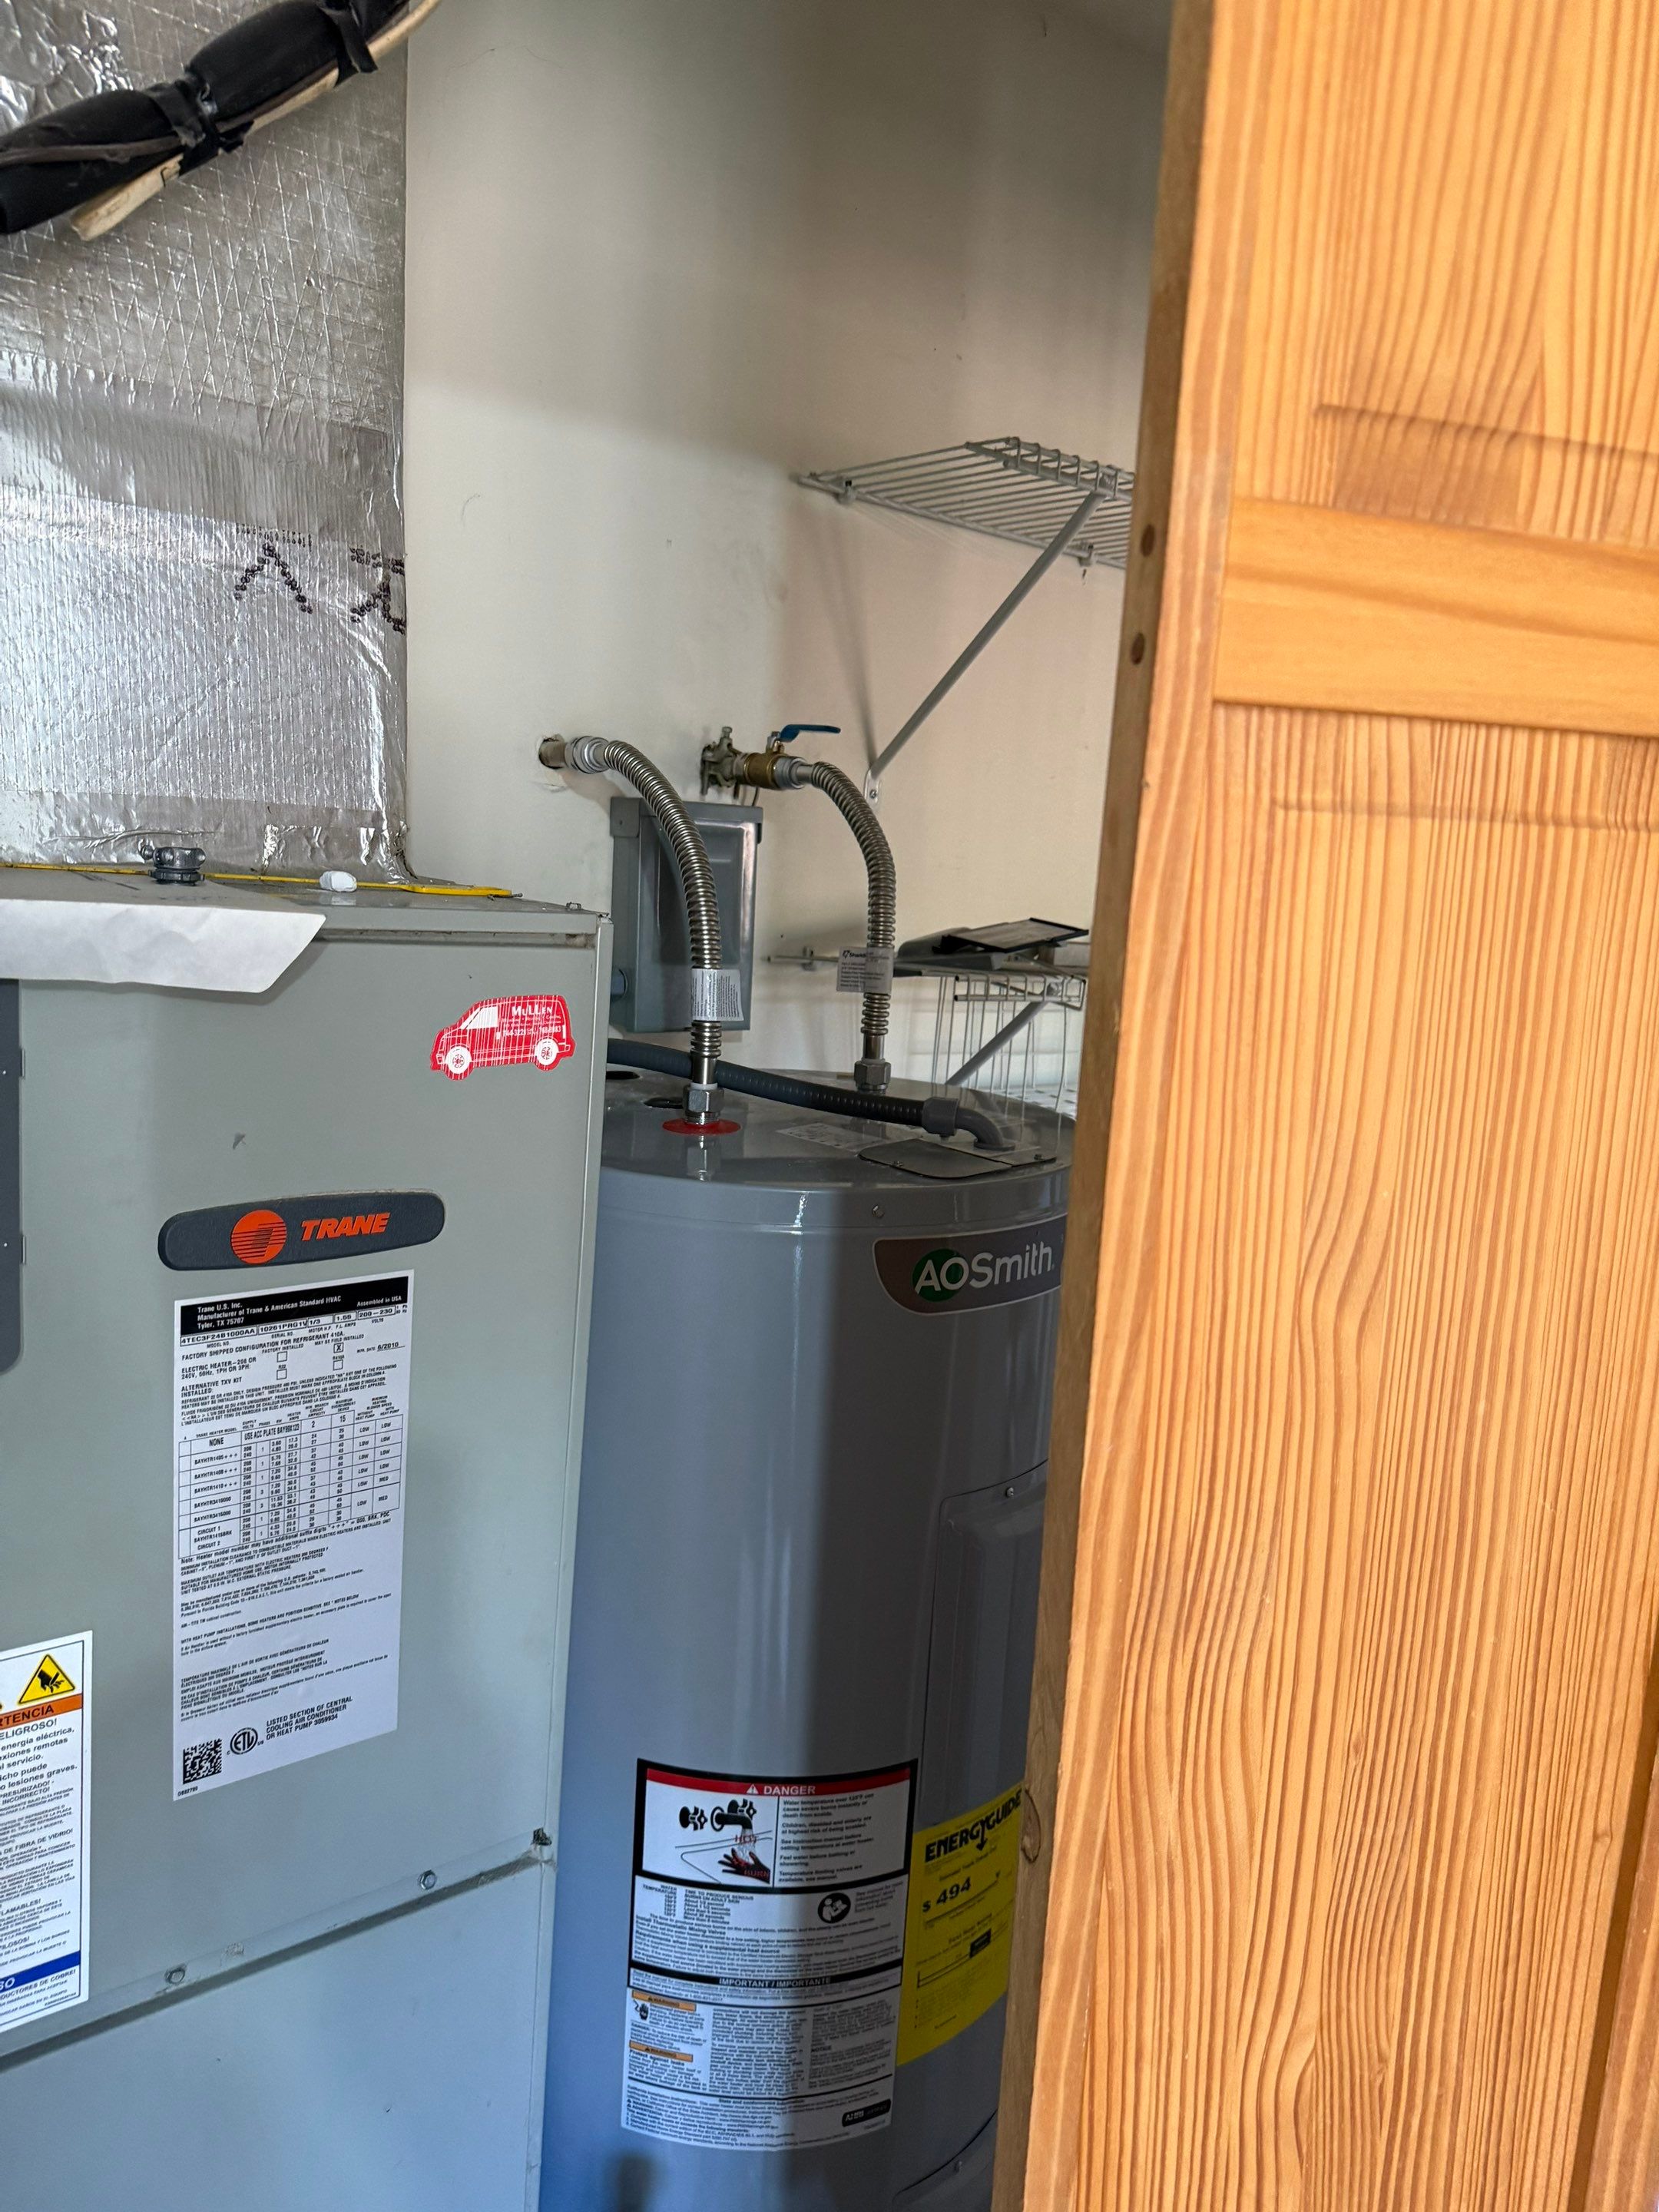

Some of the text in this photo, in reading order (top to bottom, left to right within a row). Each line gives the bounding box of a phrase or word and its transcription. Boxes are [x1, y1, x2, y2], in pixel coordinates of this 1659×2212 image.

[300, 1212, 391, 1241] TRANE
[197, 1312, 237, 1321] Manufacturer
[271, 1303, 297, 1312] American
[300, 1298, 324, 1307] Standard
[197, 1322, 214, 1330] Tyler,
[182, 1352, 207, 1360] FACTORY
[235, 1341, 279, 1353] CONFIGURATION
[293, 1334, 329, 1343] REFRIGERANT
[377, 1342, 399, 1350] 6/2010
[181, 1364, 208, 1373] ELECTRIC
[181, 1381, 219, 1392] ALTERNATIVE
[209, 1437, 224, 1446] NONE
[244, 1432, 253, 1441] USE
[263, 1428, 276, 1437] PLATE
[197, 1527, 217, 1535] CIRCUIT
[197, 1541, 217, 1550] CIRCUIT
[267, 1714, 287, 1727] LISTED
[290, 1707, 315, 1720] SECTION
[326, 1696, 353, 1709] CENTRAL
[267, 1704, 347, 1734] COOLING AIR CONDITIONER
[276, 1727, 293, 1737] HEAT
[295, 1721, 313, 1732] PUMP
[34, 1738, 68, 1751] remotas
[7, 1754, 43, 1768] servicio.
[8, 1764, 78, 1788] lesiones graves.
[21, 1763, 47, 1777] puede
[763, 1785, 816, 1795] DANGER
[936, 1876, 972, 1906] 494
[719, 1977, 830, 1988] IMPORTANT IMPORTANTE
